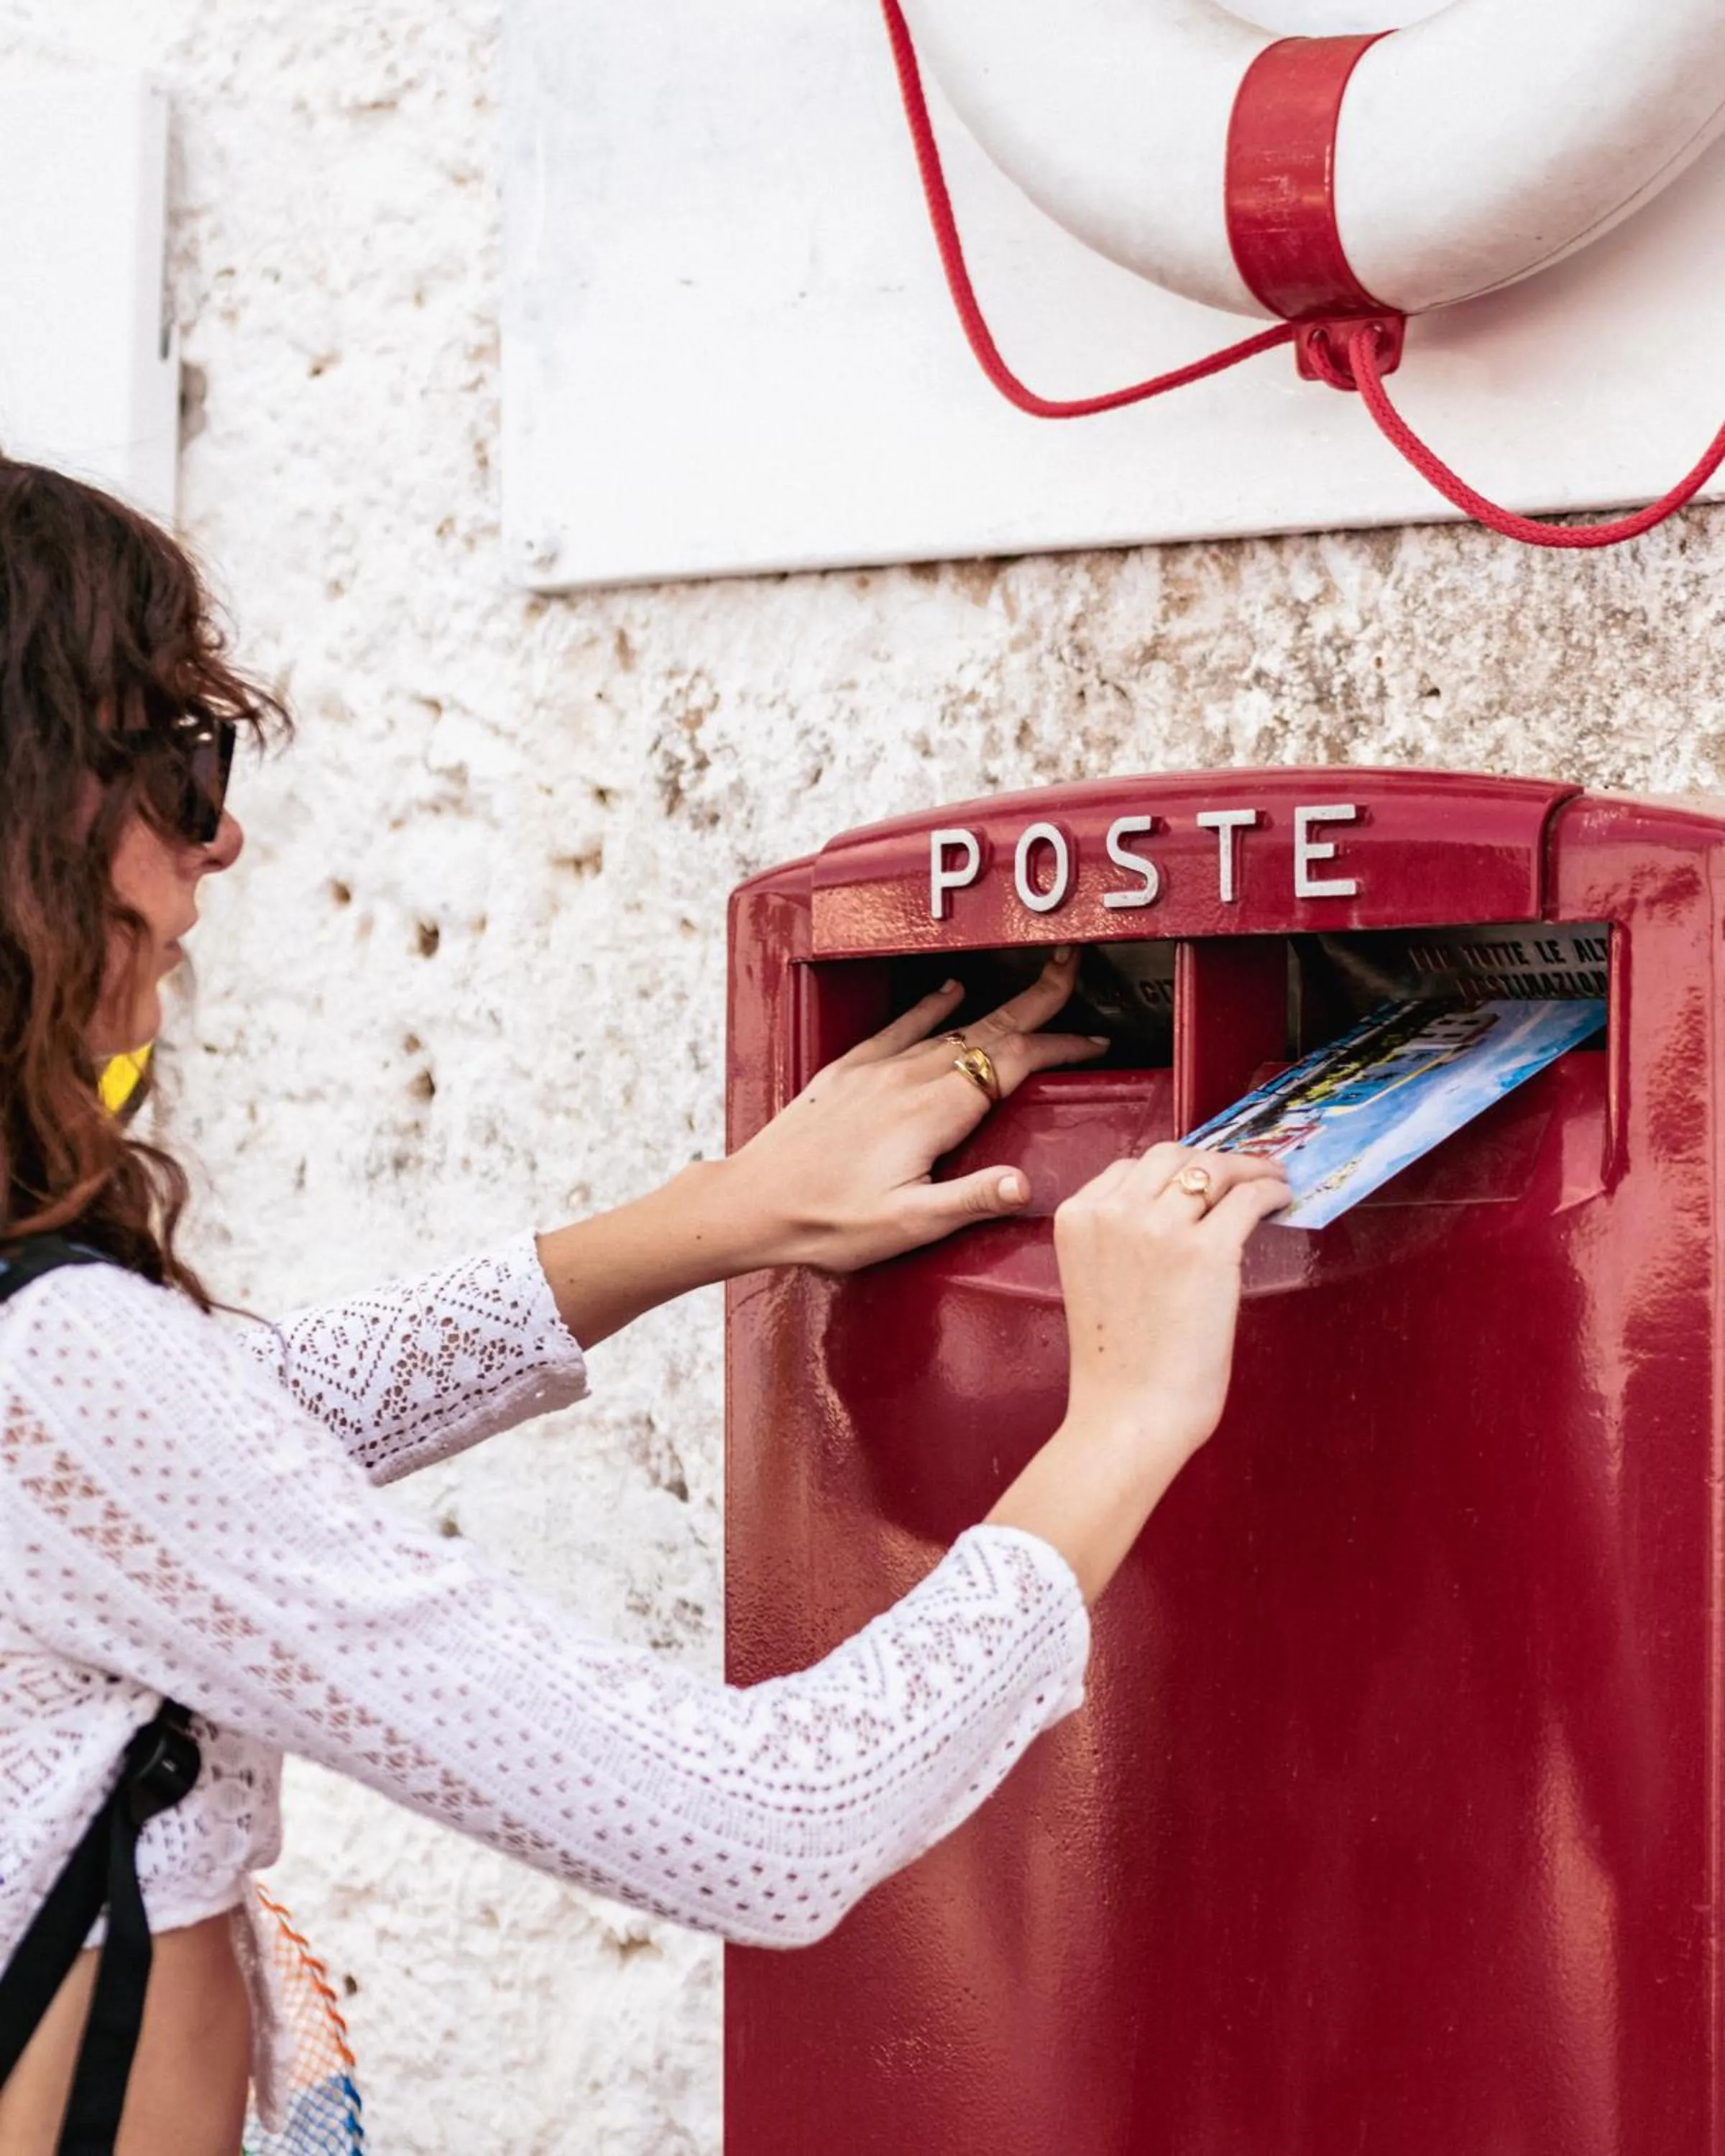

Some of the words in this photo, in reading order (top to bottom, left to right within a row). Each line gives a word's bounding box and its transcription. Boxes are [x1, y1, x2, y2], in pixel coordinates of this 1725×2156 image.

[931, 803, 1358, 920] POSTE
[1460, 941, 1530, 967] TUTTE
[1534, 940, 1566, 964] LE
